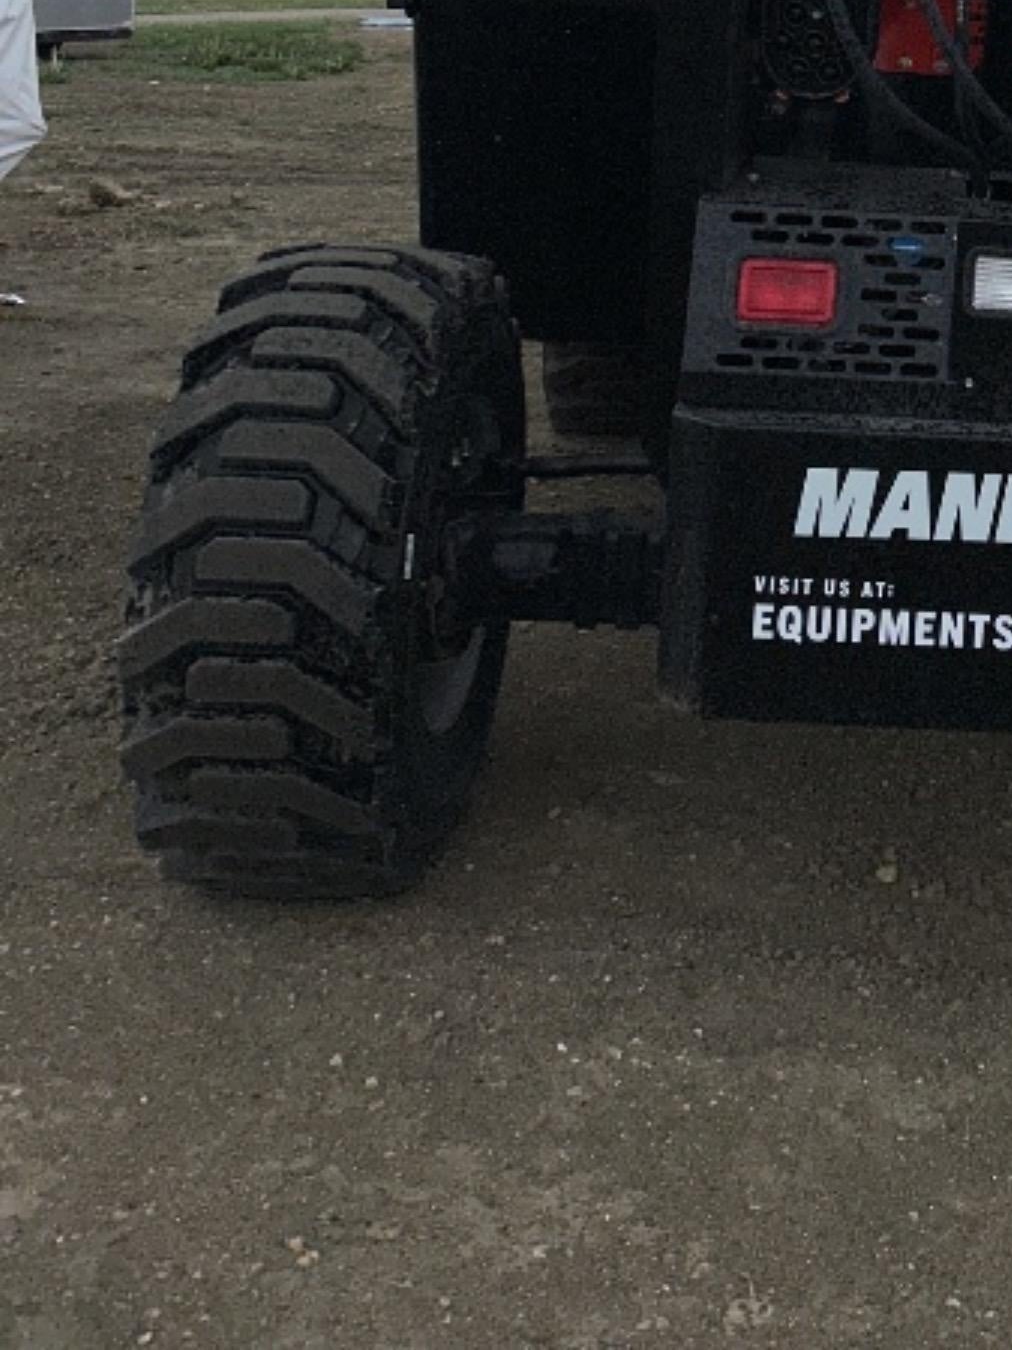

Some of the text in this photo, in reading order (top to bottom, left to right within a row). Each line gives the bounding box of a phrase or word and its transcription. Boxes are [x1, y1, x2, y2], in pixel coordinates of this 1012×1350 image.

[754, 575, 895, 599] VISIT US AT:
